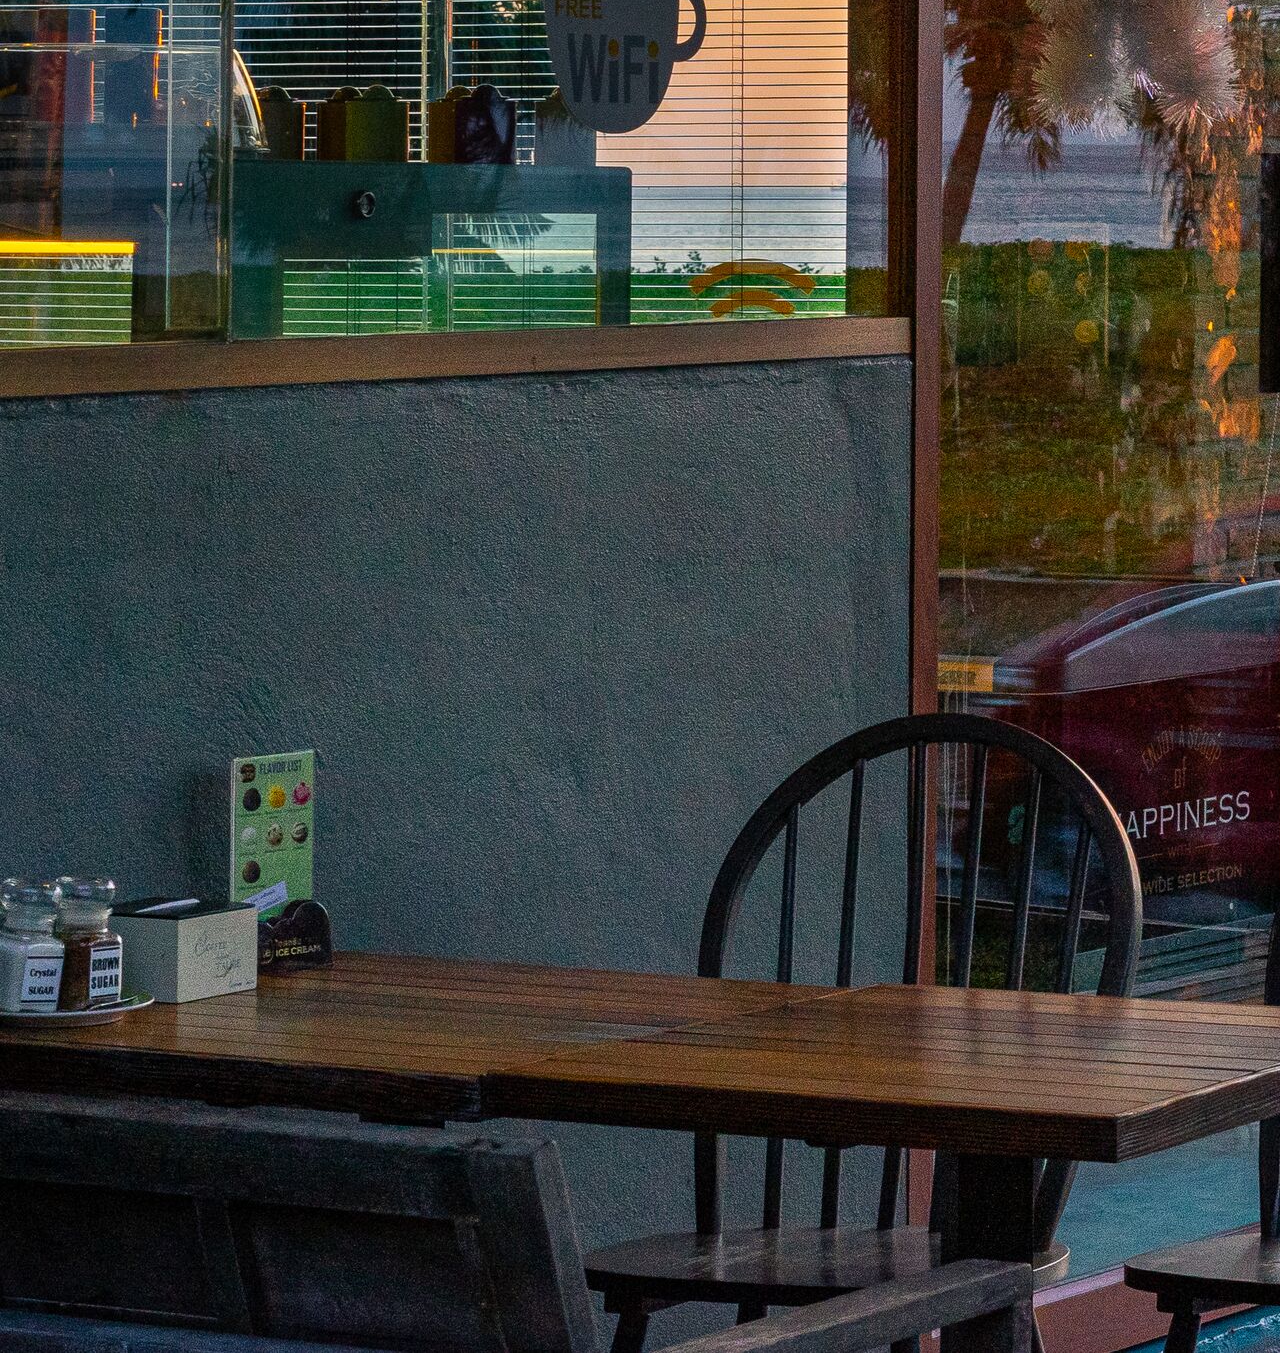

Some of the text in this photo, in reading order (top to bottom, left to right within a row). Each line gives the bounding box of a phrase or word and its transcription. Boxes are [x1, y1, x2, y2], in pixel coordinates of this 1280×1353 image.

[567, 33, 660, 105] WiFi
[286, 758, 303, 773] LIST
[1173, 755, 1188, 790] of
[1119, 790, 1252, 841] APPINESS
[1142, 864, 1243, 896] WIDE SELECTION
[276, 946, 290, 958] ICE
[290, 943, 322, 957] CREAM
[92, 956, 119, 972] BROWN
[29, 967, 57, 979] Crystal
[91, 974, 119, 990] SUGAR
[28, 985, 54, 996] SUGAR
